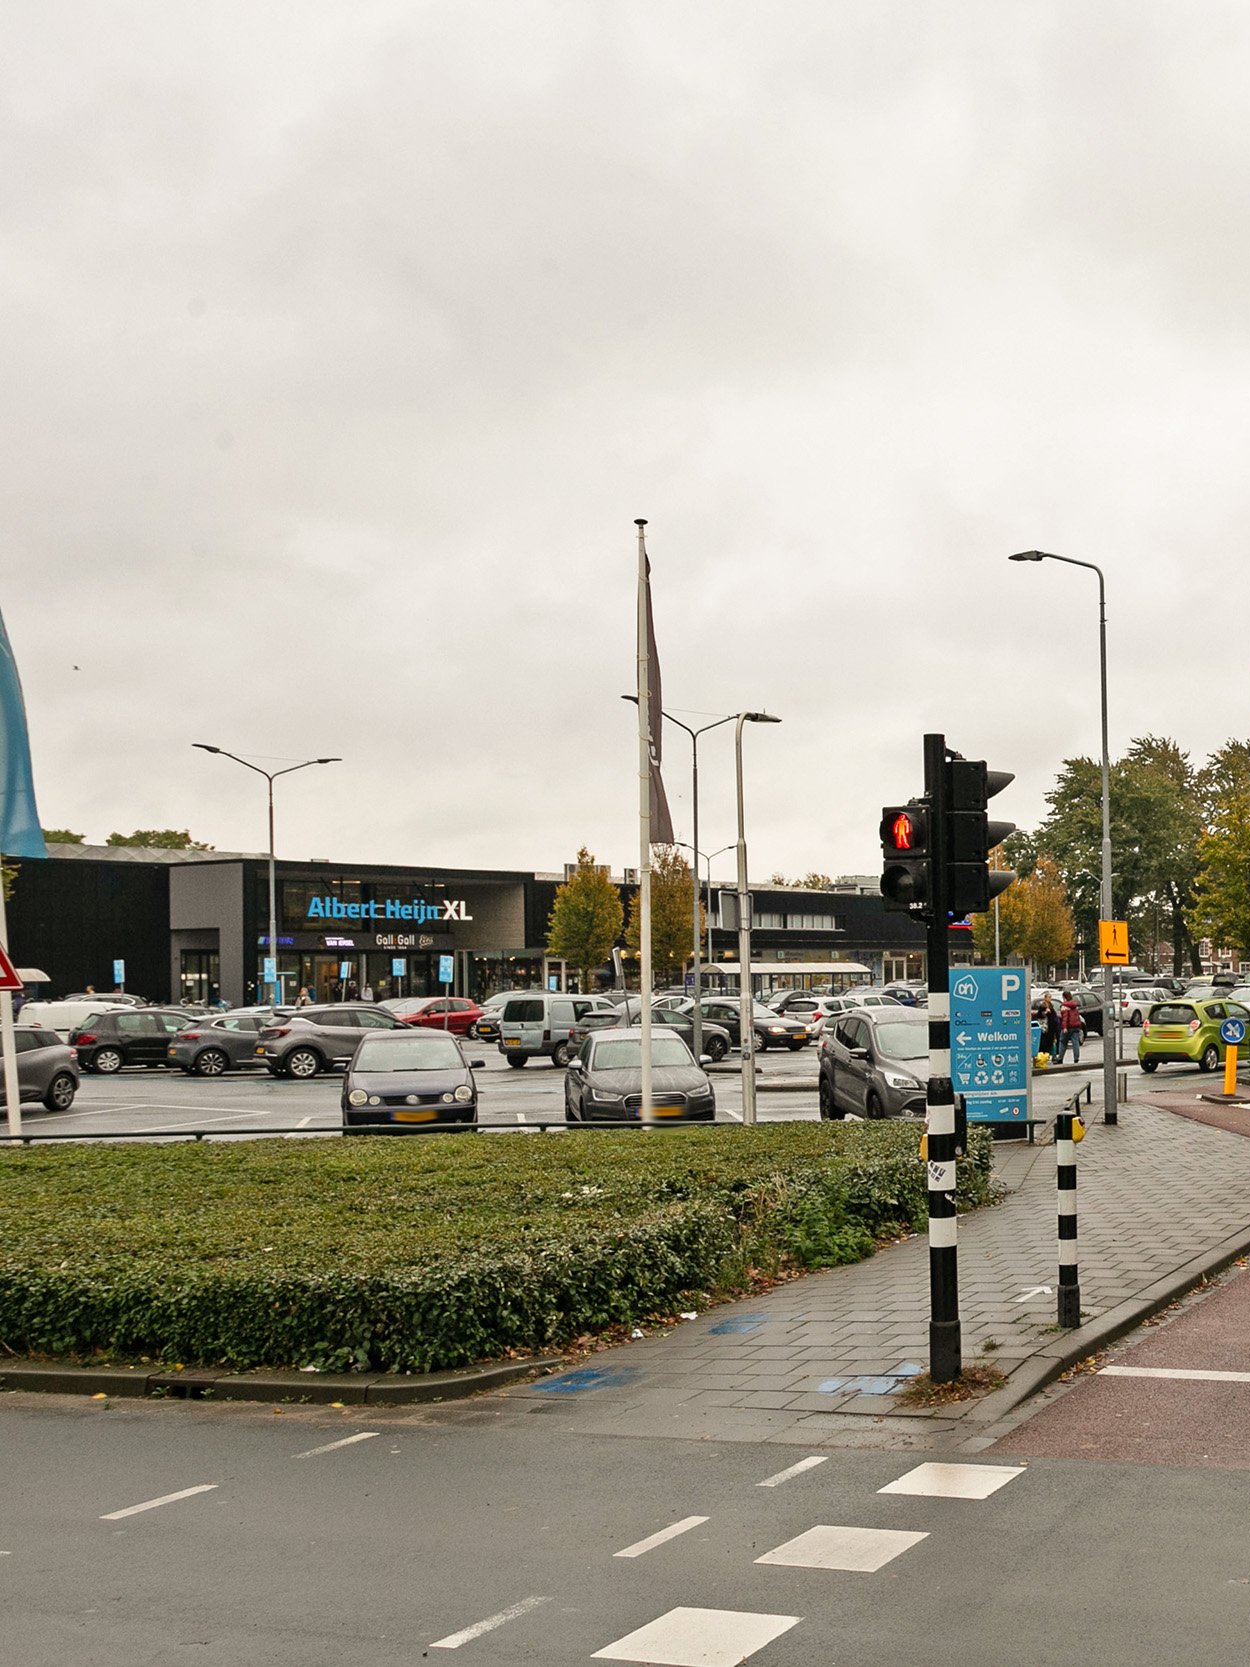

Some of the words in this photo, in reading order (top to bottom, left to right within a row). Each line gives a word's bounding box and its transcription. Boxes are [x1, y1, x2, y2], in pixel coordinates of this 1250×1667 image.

[307, 896, 379, 919] Albert
[385, 899, 438, 925] Heijn
[442, 900, 473, 921] XL
[376, 934, 394, 946] Gall
[397, 934, 415, 946] Gall
[1002, 975, 1020, 1001] P
[977, 1031, 1018, 1042] Welkom
